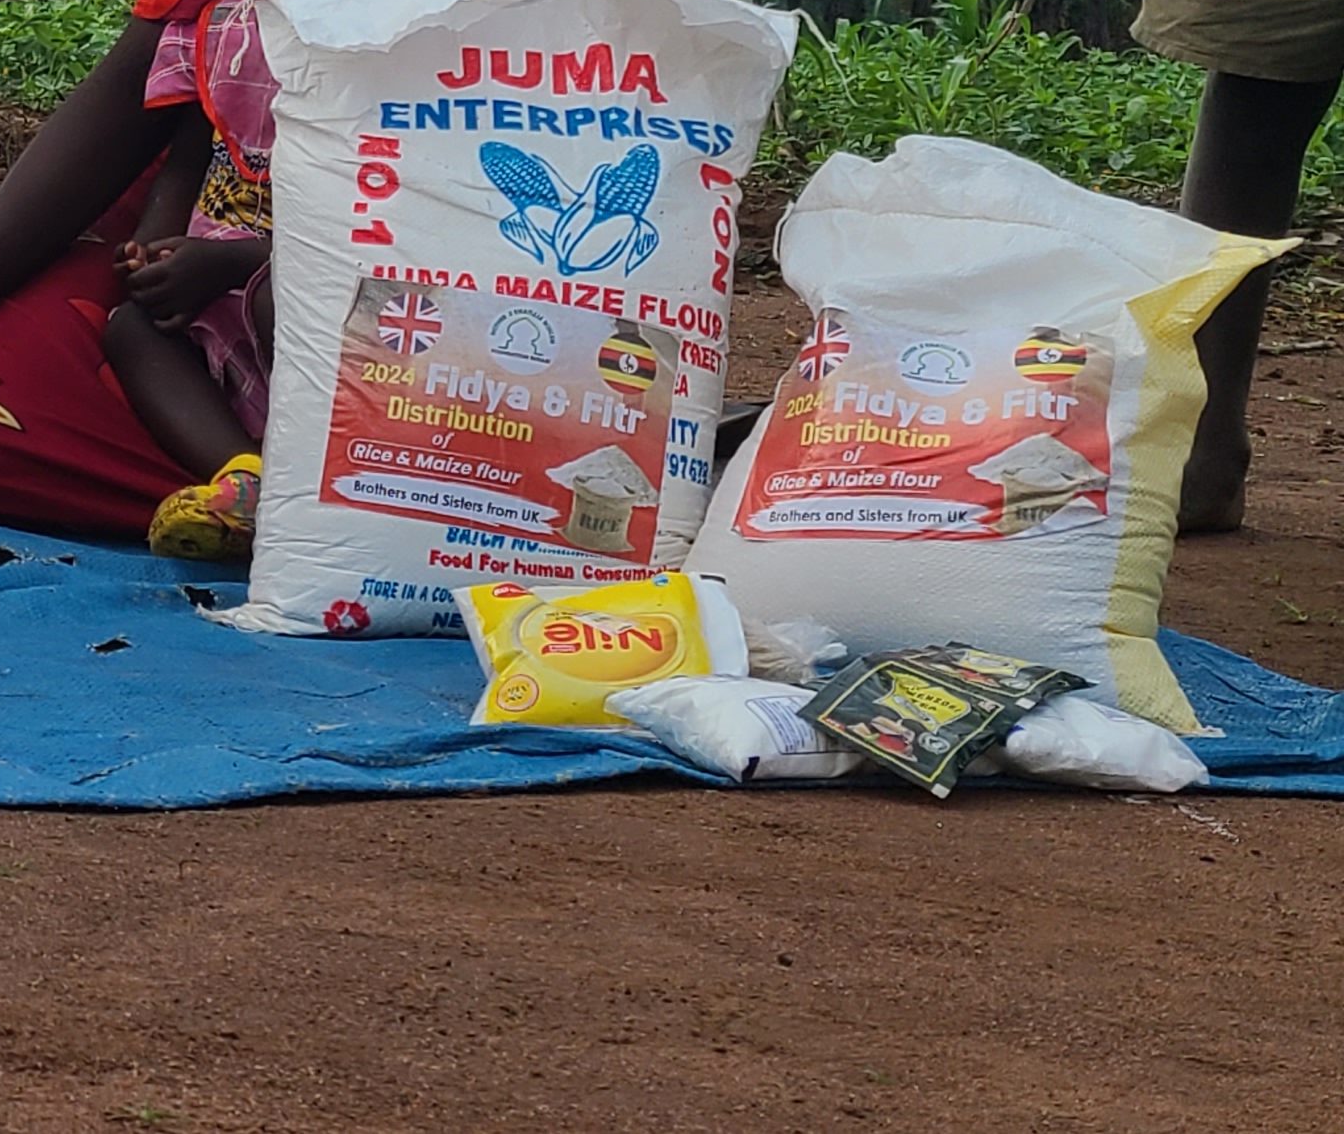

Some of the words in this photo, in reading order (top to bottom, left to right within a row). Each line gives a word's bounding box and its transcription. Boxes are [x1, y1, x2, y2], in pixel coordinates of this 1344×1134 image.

[437, 42, 668, 104] JUMA
[381, 98, 735, 156] ENTERPRISES
[351, 133, 402, 246] NO.1
[495, 275, 626, 317] MAIZE
[639, 294, 723, 343] FLOUR
[361, 362, 415, 386] 2024
[425, 363, 531, 413] Fidya
[543, 385, 570, 416] &
[580, 391, 647, 435] Fitr
[784, 390, 825, 419] 2024
[832, 381, 946, 428] Fidya
[961, 397, 989, 424] &
[1002, 388, 1079, 421] Fitr
[386, 395, 534, 443] Distribution
[800, 419, 951, 448] Distribution
[431, 431, 454, 449] of
[842, 446, 865, 464] of
[353, 443, 393, 463] Rice
[396, 450, 411, 466] &
[414, 452, 473, 477] Maize
[475, 462, 522, 485] flour
[769, 474, 806, 491] Rice
[827, 470, 885, 488] Maize
[889, 470, 942, 489] flour
[353, 480, 407, 501] Brothers
[410, 489, 439, 506] and
[442, 494, 484, 513] Sisters
[486, 499, 518, 521] from
[521, 508, 540, 523] UK
[769, 509, 822, 523] Brothers
[825, 509, 854, 522] and
[858, 508, 903, 522] Sisters
[907, 509, 943, 523] from
[947, 510, 968, 523] UK
[429, 549, 473, 570] Food
[479, 553, 509, 574] For
[360, 578, 399, 600] STORE
[401, 583, 416, 600] IN
[419, 585, 428, 602] A
[432, 612, 464, 628] NE
[543, 622, 663, 653] Nile
